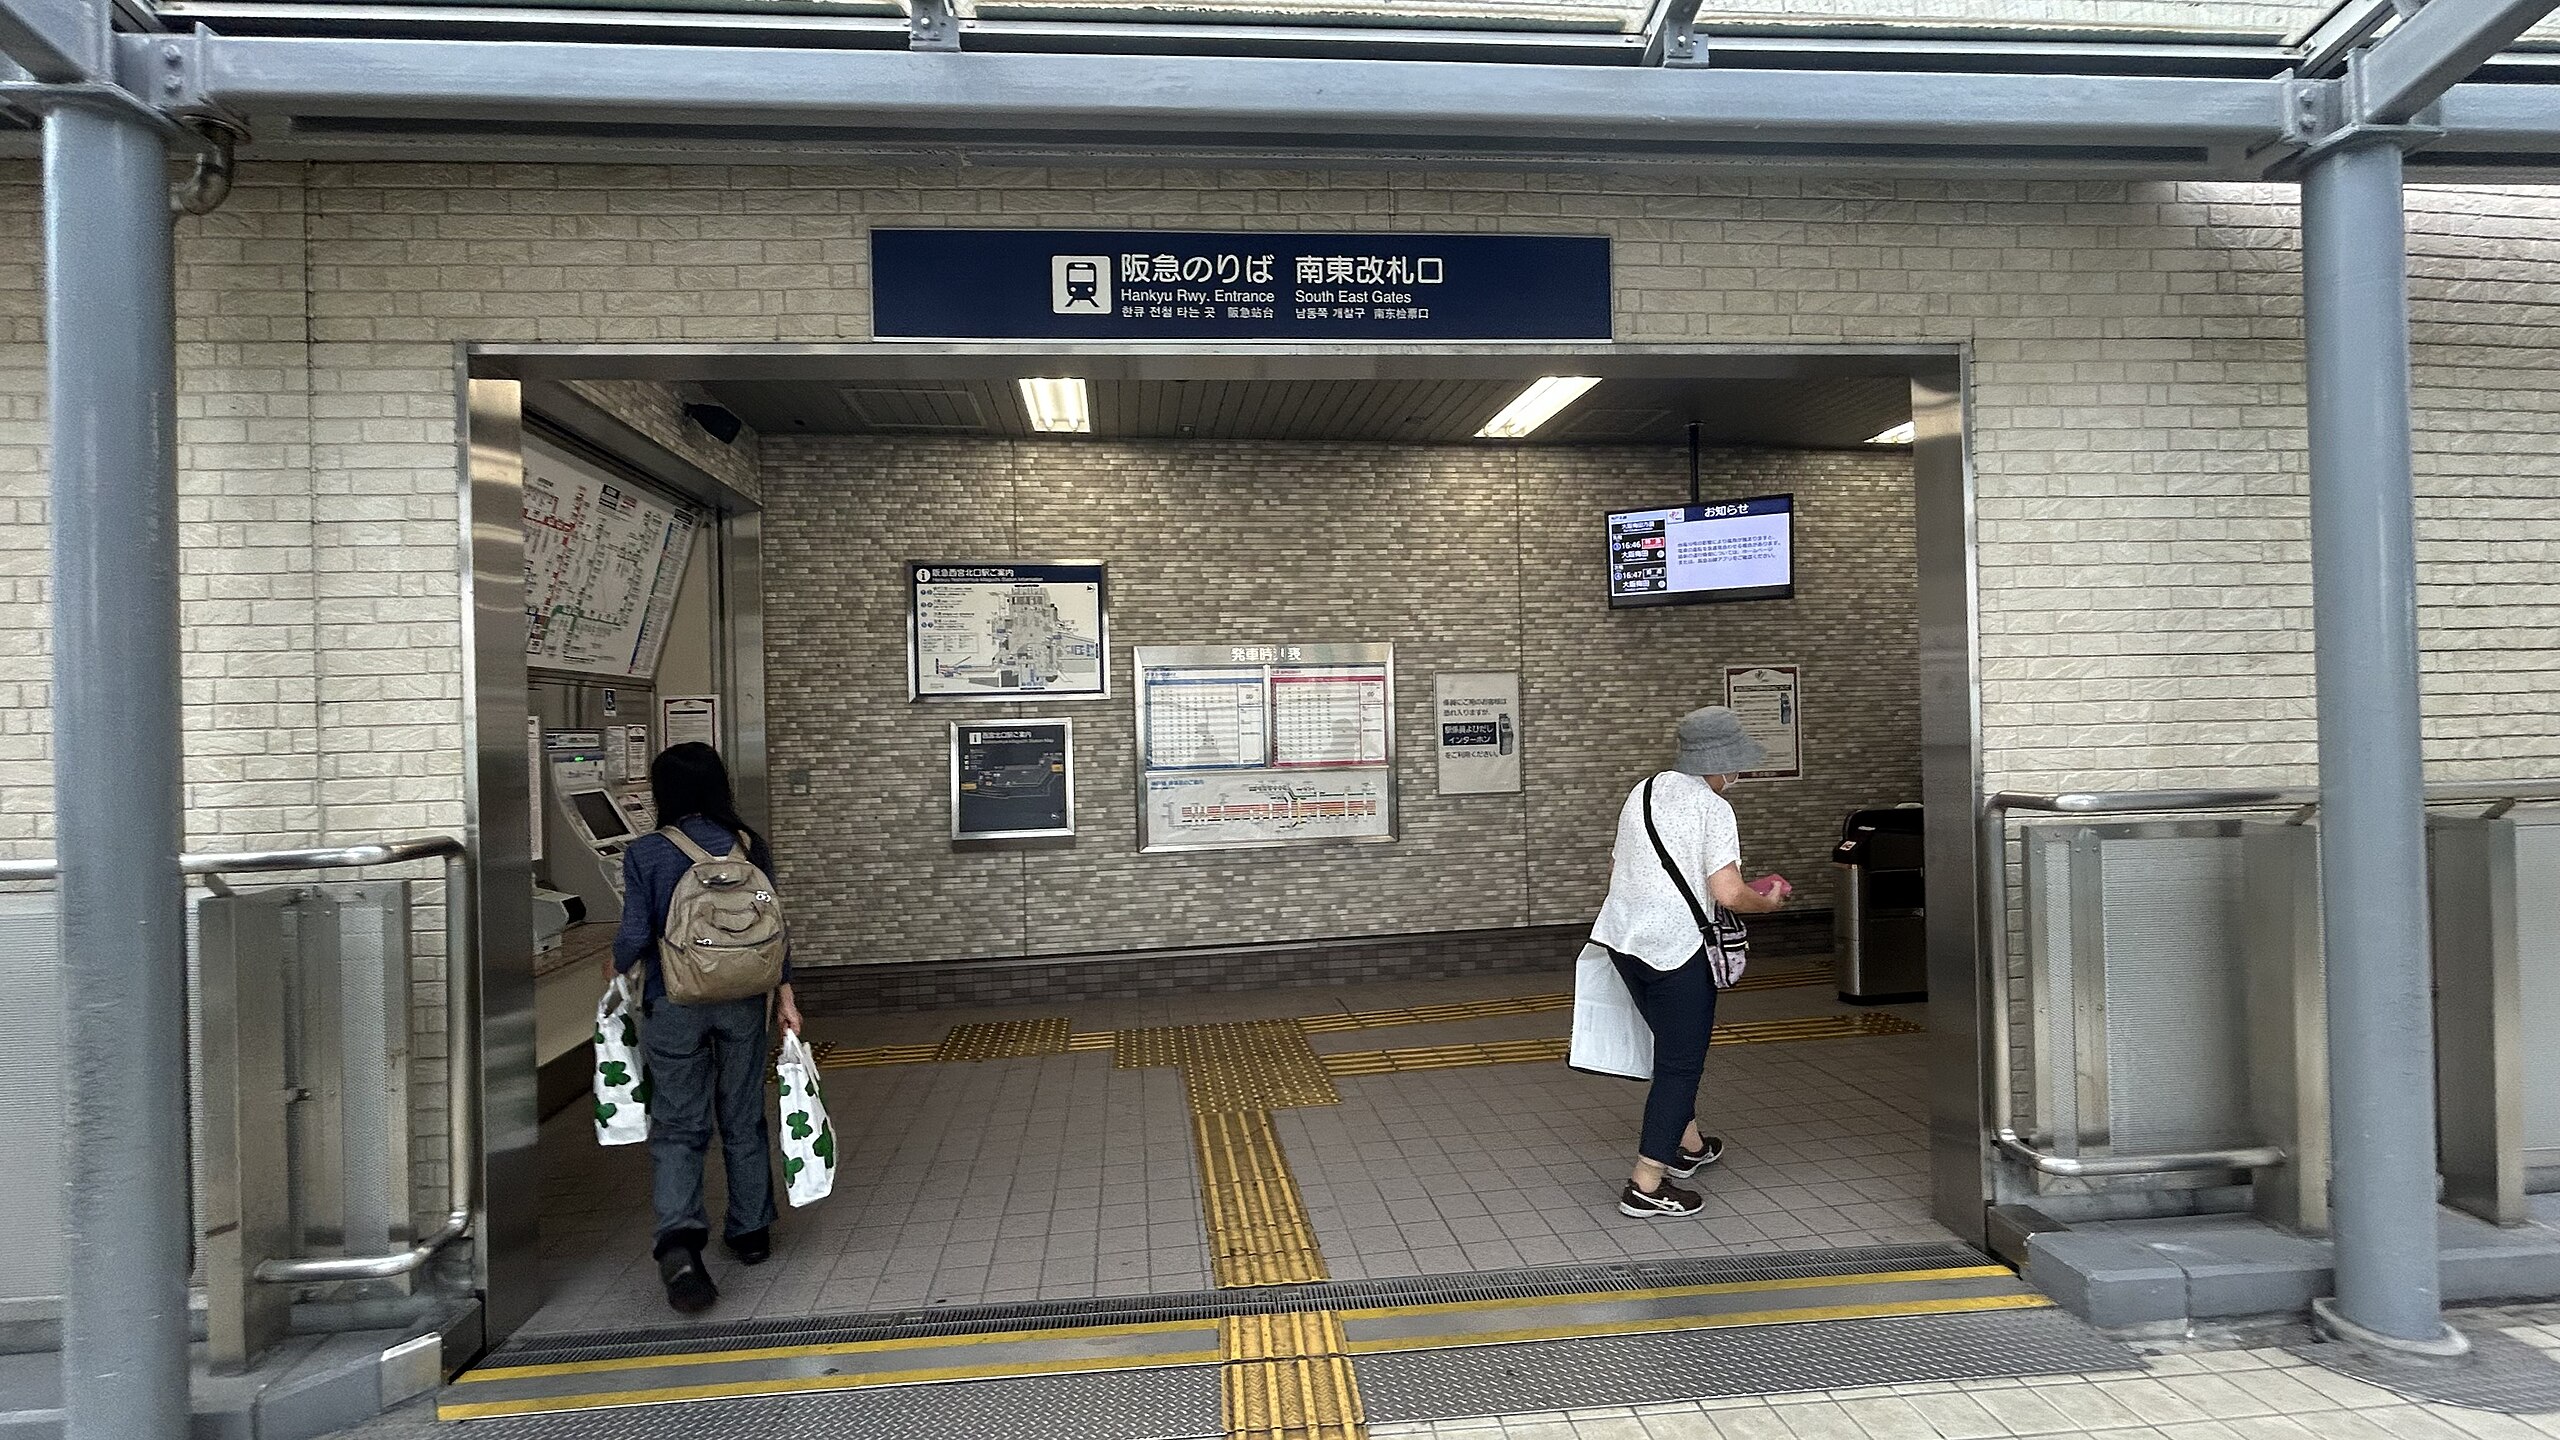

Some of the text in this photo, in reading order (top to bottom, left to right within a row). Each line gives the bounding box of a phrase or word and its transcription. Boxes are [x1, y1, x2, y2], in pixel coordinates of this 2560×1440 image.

[1120, 253, 1444, 285] 阪急のりば 南東改札口
[1120, 288, 1412, 304] Hankyu Rwy. Entrance South East Gates
[1121, 306, 1145, 318] 한큐
[1176, 306, 1200, 318] 타는
[1204, 306, 1216, 318] 곳
[1704, 503, 1750, 518] お知らせ
[1448, 735, 1491, 745] インターホン
